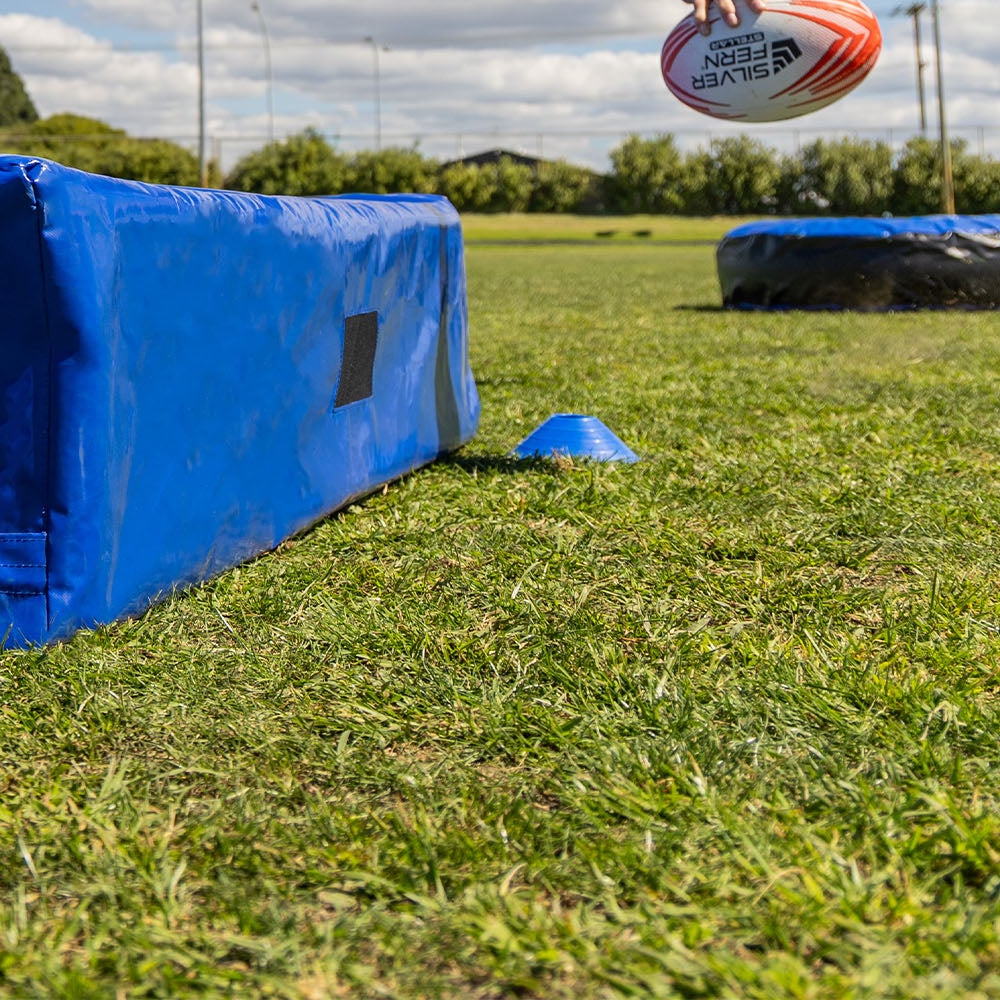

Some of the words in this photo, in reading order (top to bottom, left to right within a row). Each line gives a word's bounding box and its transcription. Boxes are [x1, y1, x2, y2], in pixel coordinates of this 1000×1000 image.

[711, 32, 763, 50] STELLAR
[704, 43, 768, 70] FERN
[691, 62, 770, 90] SILVER
